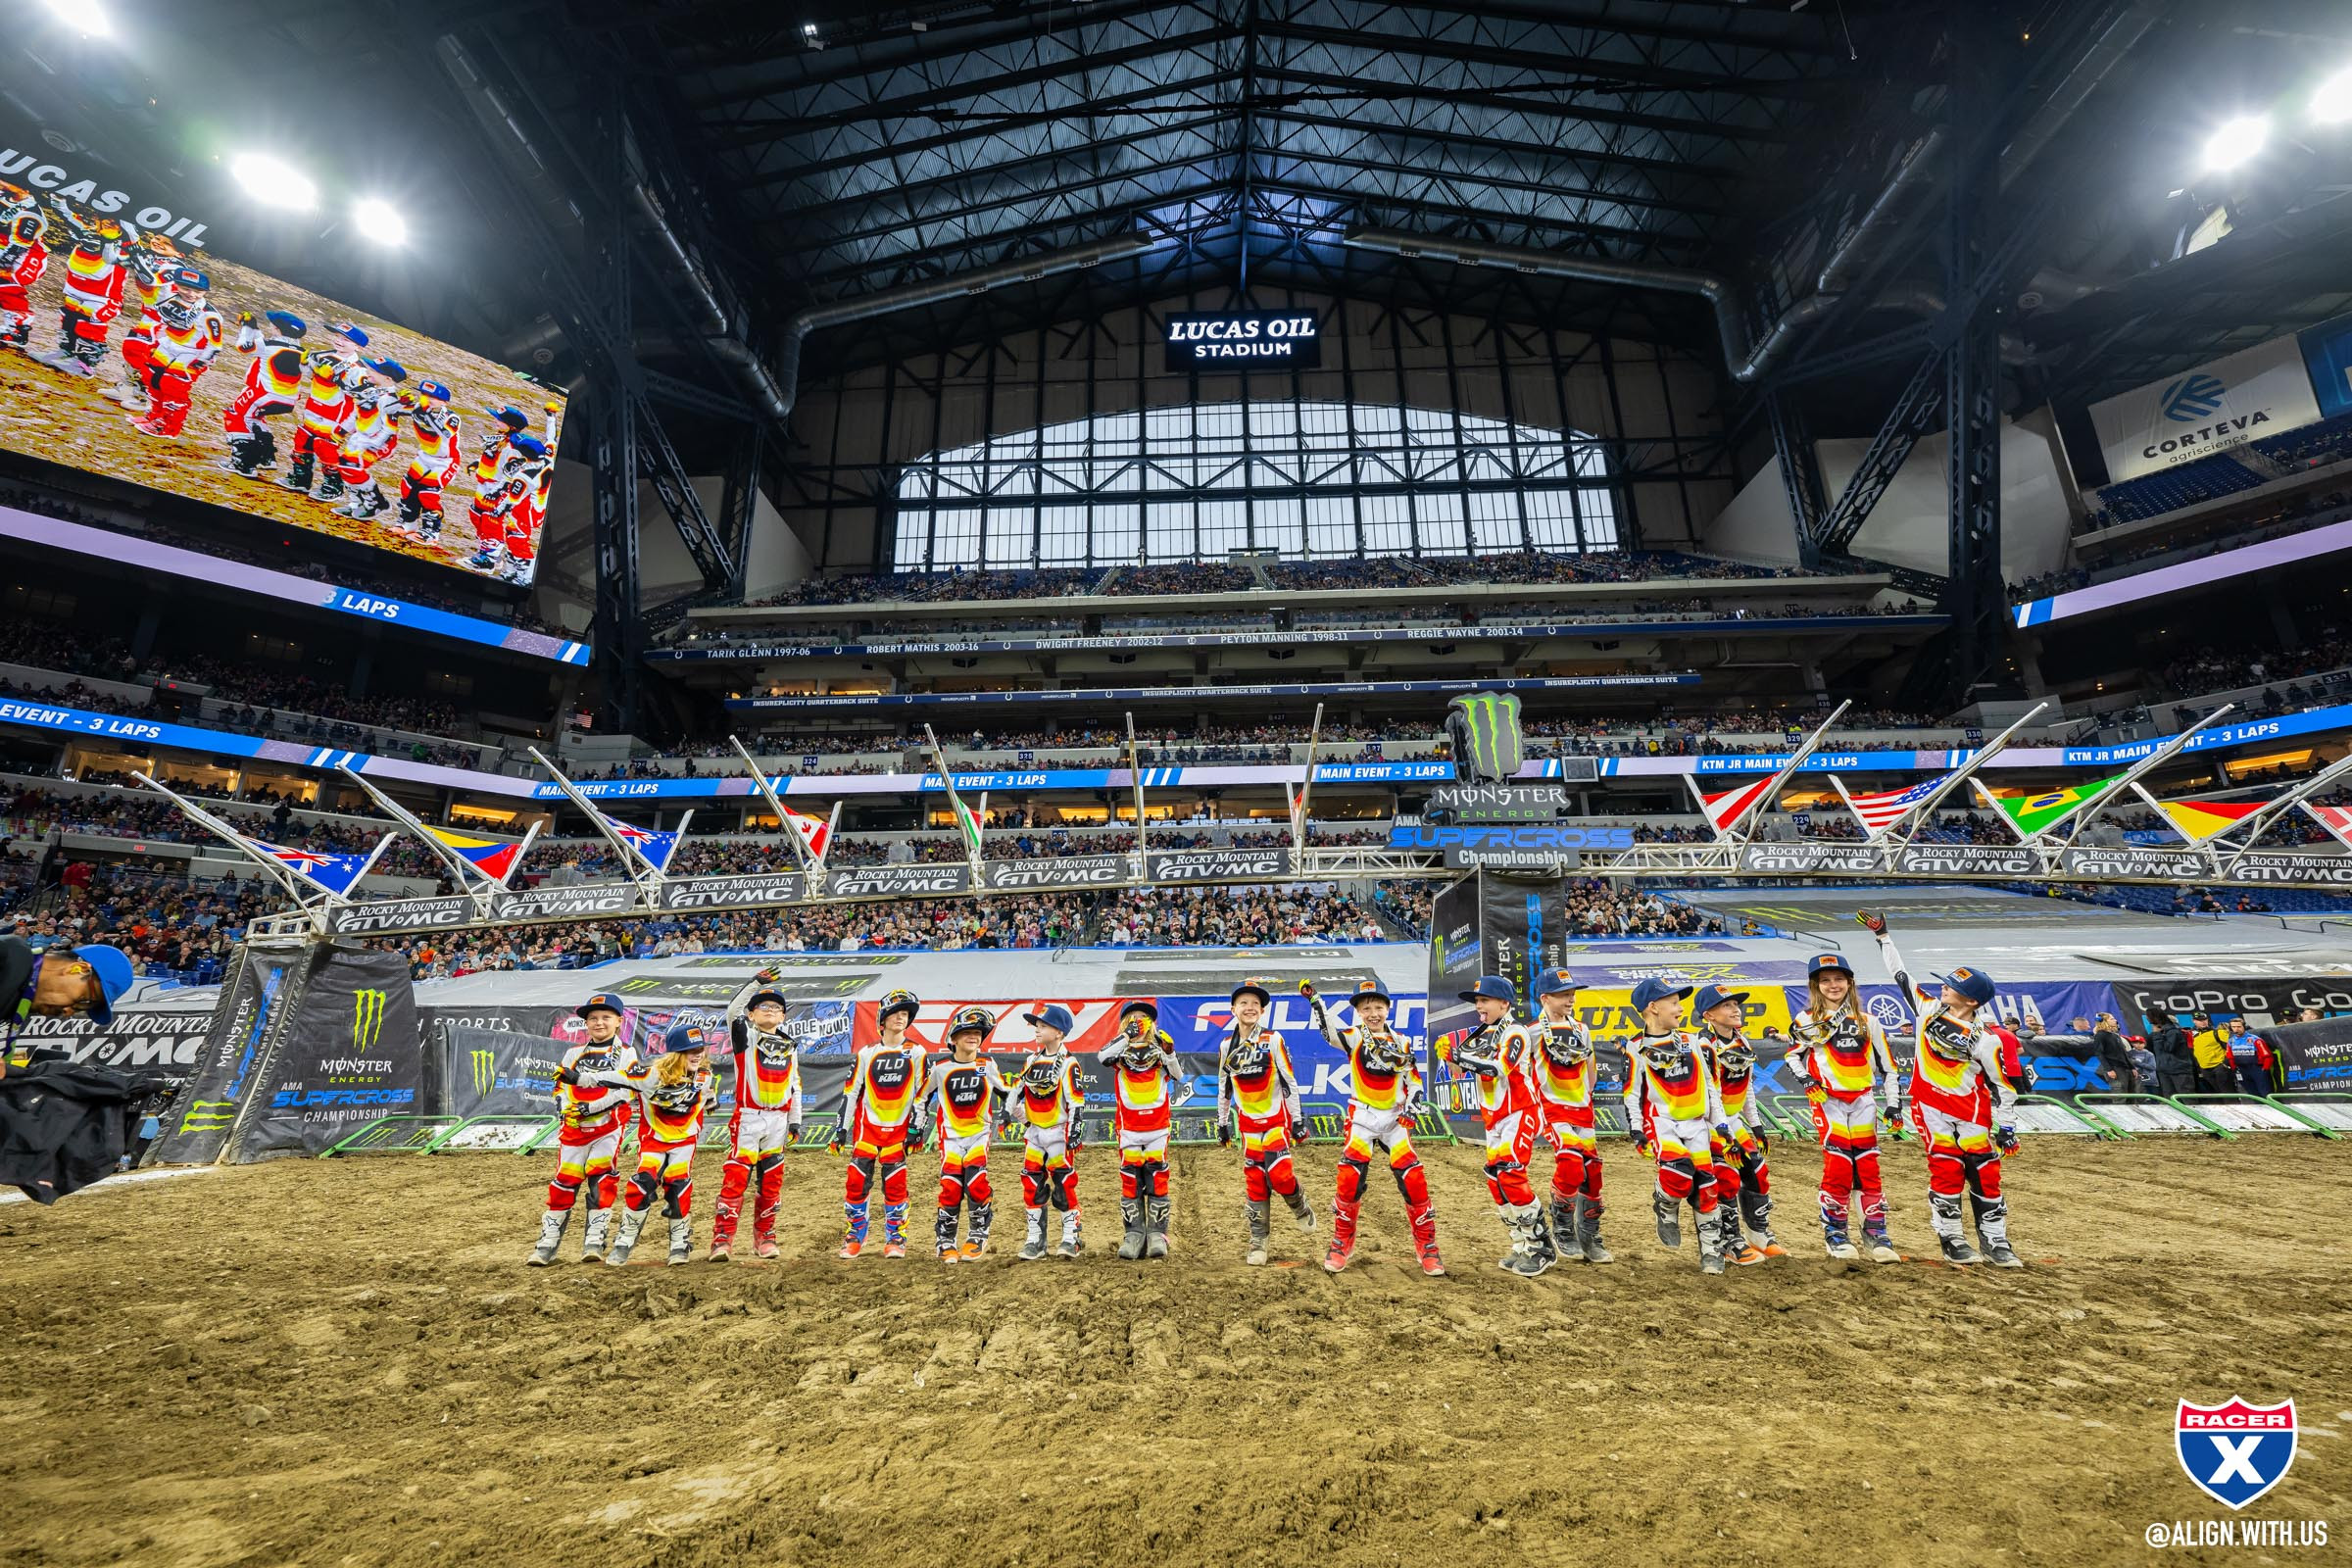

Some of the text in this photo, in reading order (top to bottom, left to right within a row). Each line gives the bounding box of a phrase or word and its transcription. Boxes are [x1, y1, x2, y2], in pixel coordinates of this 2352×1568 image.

[135, 207, 208, 248] OIL
[1169, 318, 1315, 340] LUCAS OIL
[1195, 343, 1292, 358] STADIUM
[2142, 412, 2271, 460] CORTEVA
[2169, 433, 2249, 464] agriscience
[342, 594, 400, 618] LAPS
[1220, 633, 1348, 644] PEYTON MANNING 1998-11
[1447, 629, 1481, 638] WAYNE
[866, 645, 901, 654] ROBERT
[905, 644, 940, 653] MATHIS
[1036, 638, 1163, 649] DWIGHT FREENEY 2002-12
[707, 648, 810, 659] TARIK GLENN 1997-06
[0, 704, 70, 725] EVENT
[89, 718, 105, 730] 3
[108, 721, 161, 738] LAPS
[2069, 722, 2279, 761] KTM JR MAIN 3 LAPS
[1702, 757, 1858, 769] KTM JR MAIN 3 LAPS
[1320, 765, 1446, 778] MAIN EVENT 3 LAPS
[957, 774, 1047, 787] EVENT 3 LAPS
[618, 784, 627, 795] 3
[629, 783, 659, 794] LAPS
[1439, 785, 1568, 807] MONSTER
[1460, 809, 1548, 818] ENERGY
[1396, 816, 1422, 827] AMA
[1389, 828, 1637, 848] SUPERCROSS
[1176, 851, 1279, 864] ROCKY MOUNTAIN
[1458, 850, 1568, 867] Championship
[1767, 846, 1871, 857] ROCKY MOUNTAIN
[1922, 848, 2027, 858] ROCKY MOUNTAIN
[2089, 851, 2127, 860] ROCKY
[1013, 858, 1116, 871] ROCKY MOUNTAIN
[2249, 856, 2286, 866] ROCKY
[855, 868, 959, 880] ROCKY MOUNTAIN
[690, 877, 794, 892] ROCKY MOUNTAIN
[520, 888, 627, 903] ROCKY MOUNTAIN
[357, 900, 464, 917] ROCKY MOUNTAIN
[2133, 990, 2269, 1010] GoPro
[20, 1015, 101, 1036] ROCKY
[217, 997, 253, 1067] MONSTER
[235, 1007, 257, 1056] ENERGY
[251, 995, 283, 1070] CHAMPIONSHIP
[818, 1017, 849, 1037] NOW!
[1509, 1039, 1521, 1060] TLD
[319, 1057, 392, 1074] MONSTER
[514, 1056, 557, 1069] MONSTER
[876, 1058, 905, 1070] TLD
[878, 1073, 903, 1083] KTM
[951, 1078, 980, 1089] TLD
[222, 1079, 233, 1096] AMA
[281, 1082, 302, 1091] AMA
[270, 1089, 416, 1108] SUPERCROSS
[955, 1092, 977, 1102] KTM
[1435, 1082, 1450, 1110] 100
[303, 1108, 388, 1123] CHAMPIONSHIP
[1519, 1113, 1536, 1151] TLD
